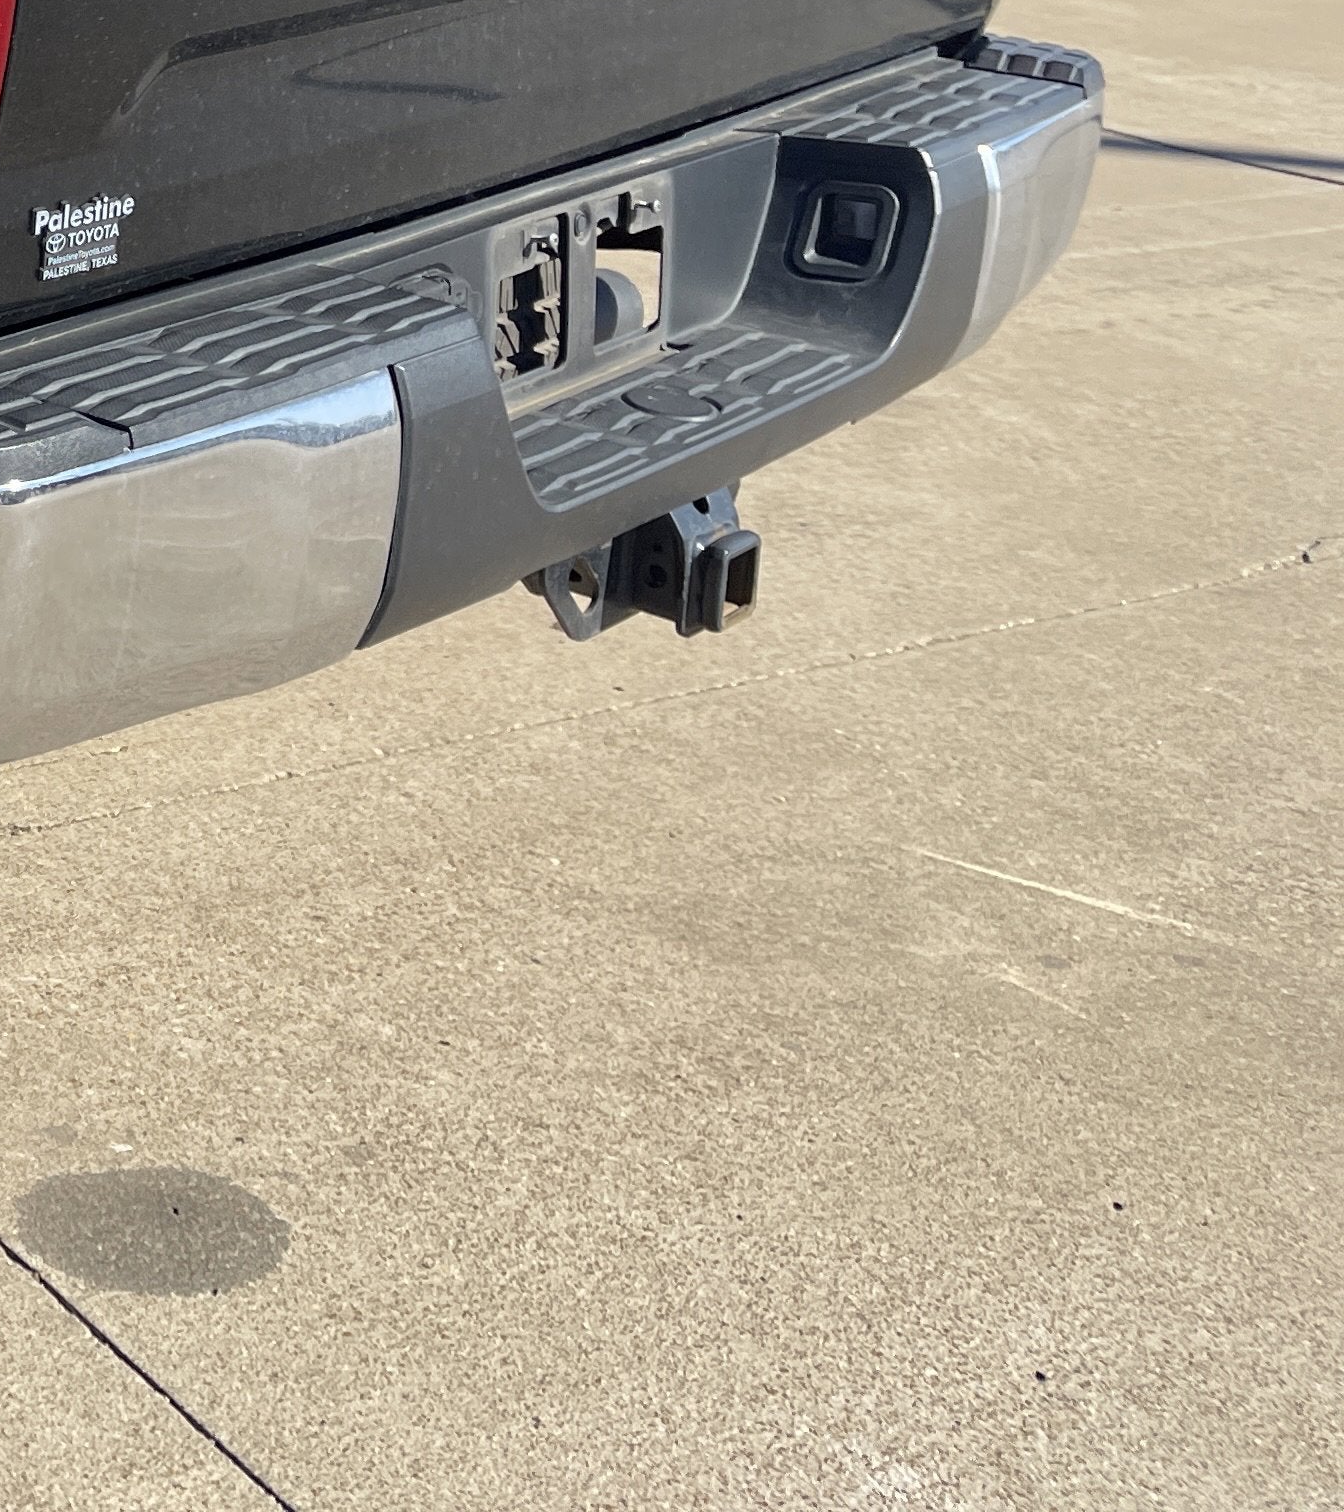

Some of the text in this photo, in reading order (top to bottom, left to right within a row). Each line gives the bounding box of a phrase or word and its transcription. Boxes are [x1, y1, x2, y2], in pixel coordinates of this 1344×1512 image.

[34, 195, 136, 236] Palestine
[68, 222, 120, 248] TOYOTA
[91, 253, 118, 269] TEXAS
